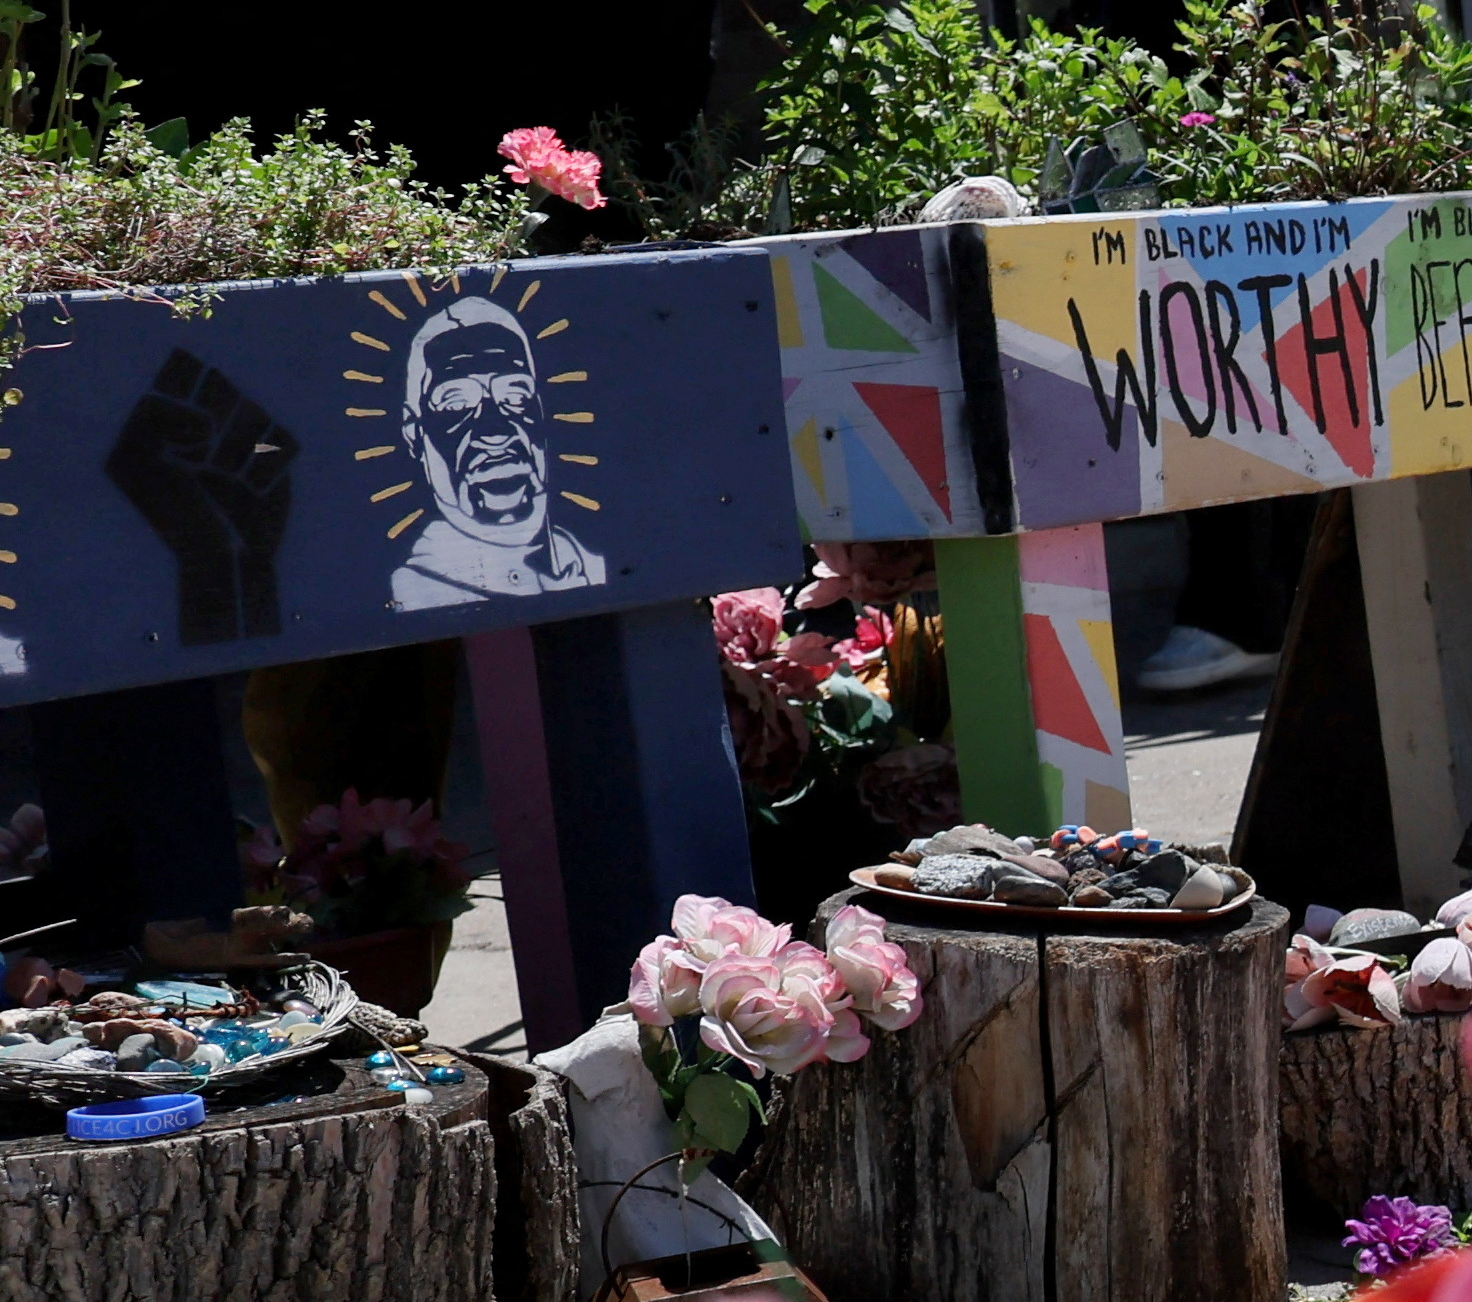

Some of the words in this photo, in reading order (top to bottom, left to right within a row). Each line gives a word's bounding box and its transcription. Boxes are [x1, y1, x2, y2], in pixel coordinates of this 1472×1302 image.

[1092, 229, 1126, 267] I'M
[1145, 223, 1233, 262] BLACK
[1246, 219, 1306, 256] AND
[1313, 216, 1352, 252] I'M
[1408, 206, 1443, 242] I'M
[1067, 258, 1385, 452] WORTHY
